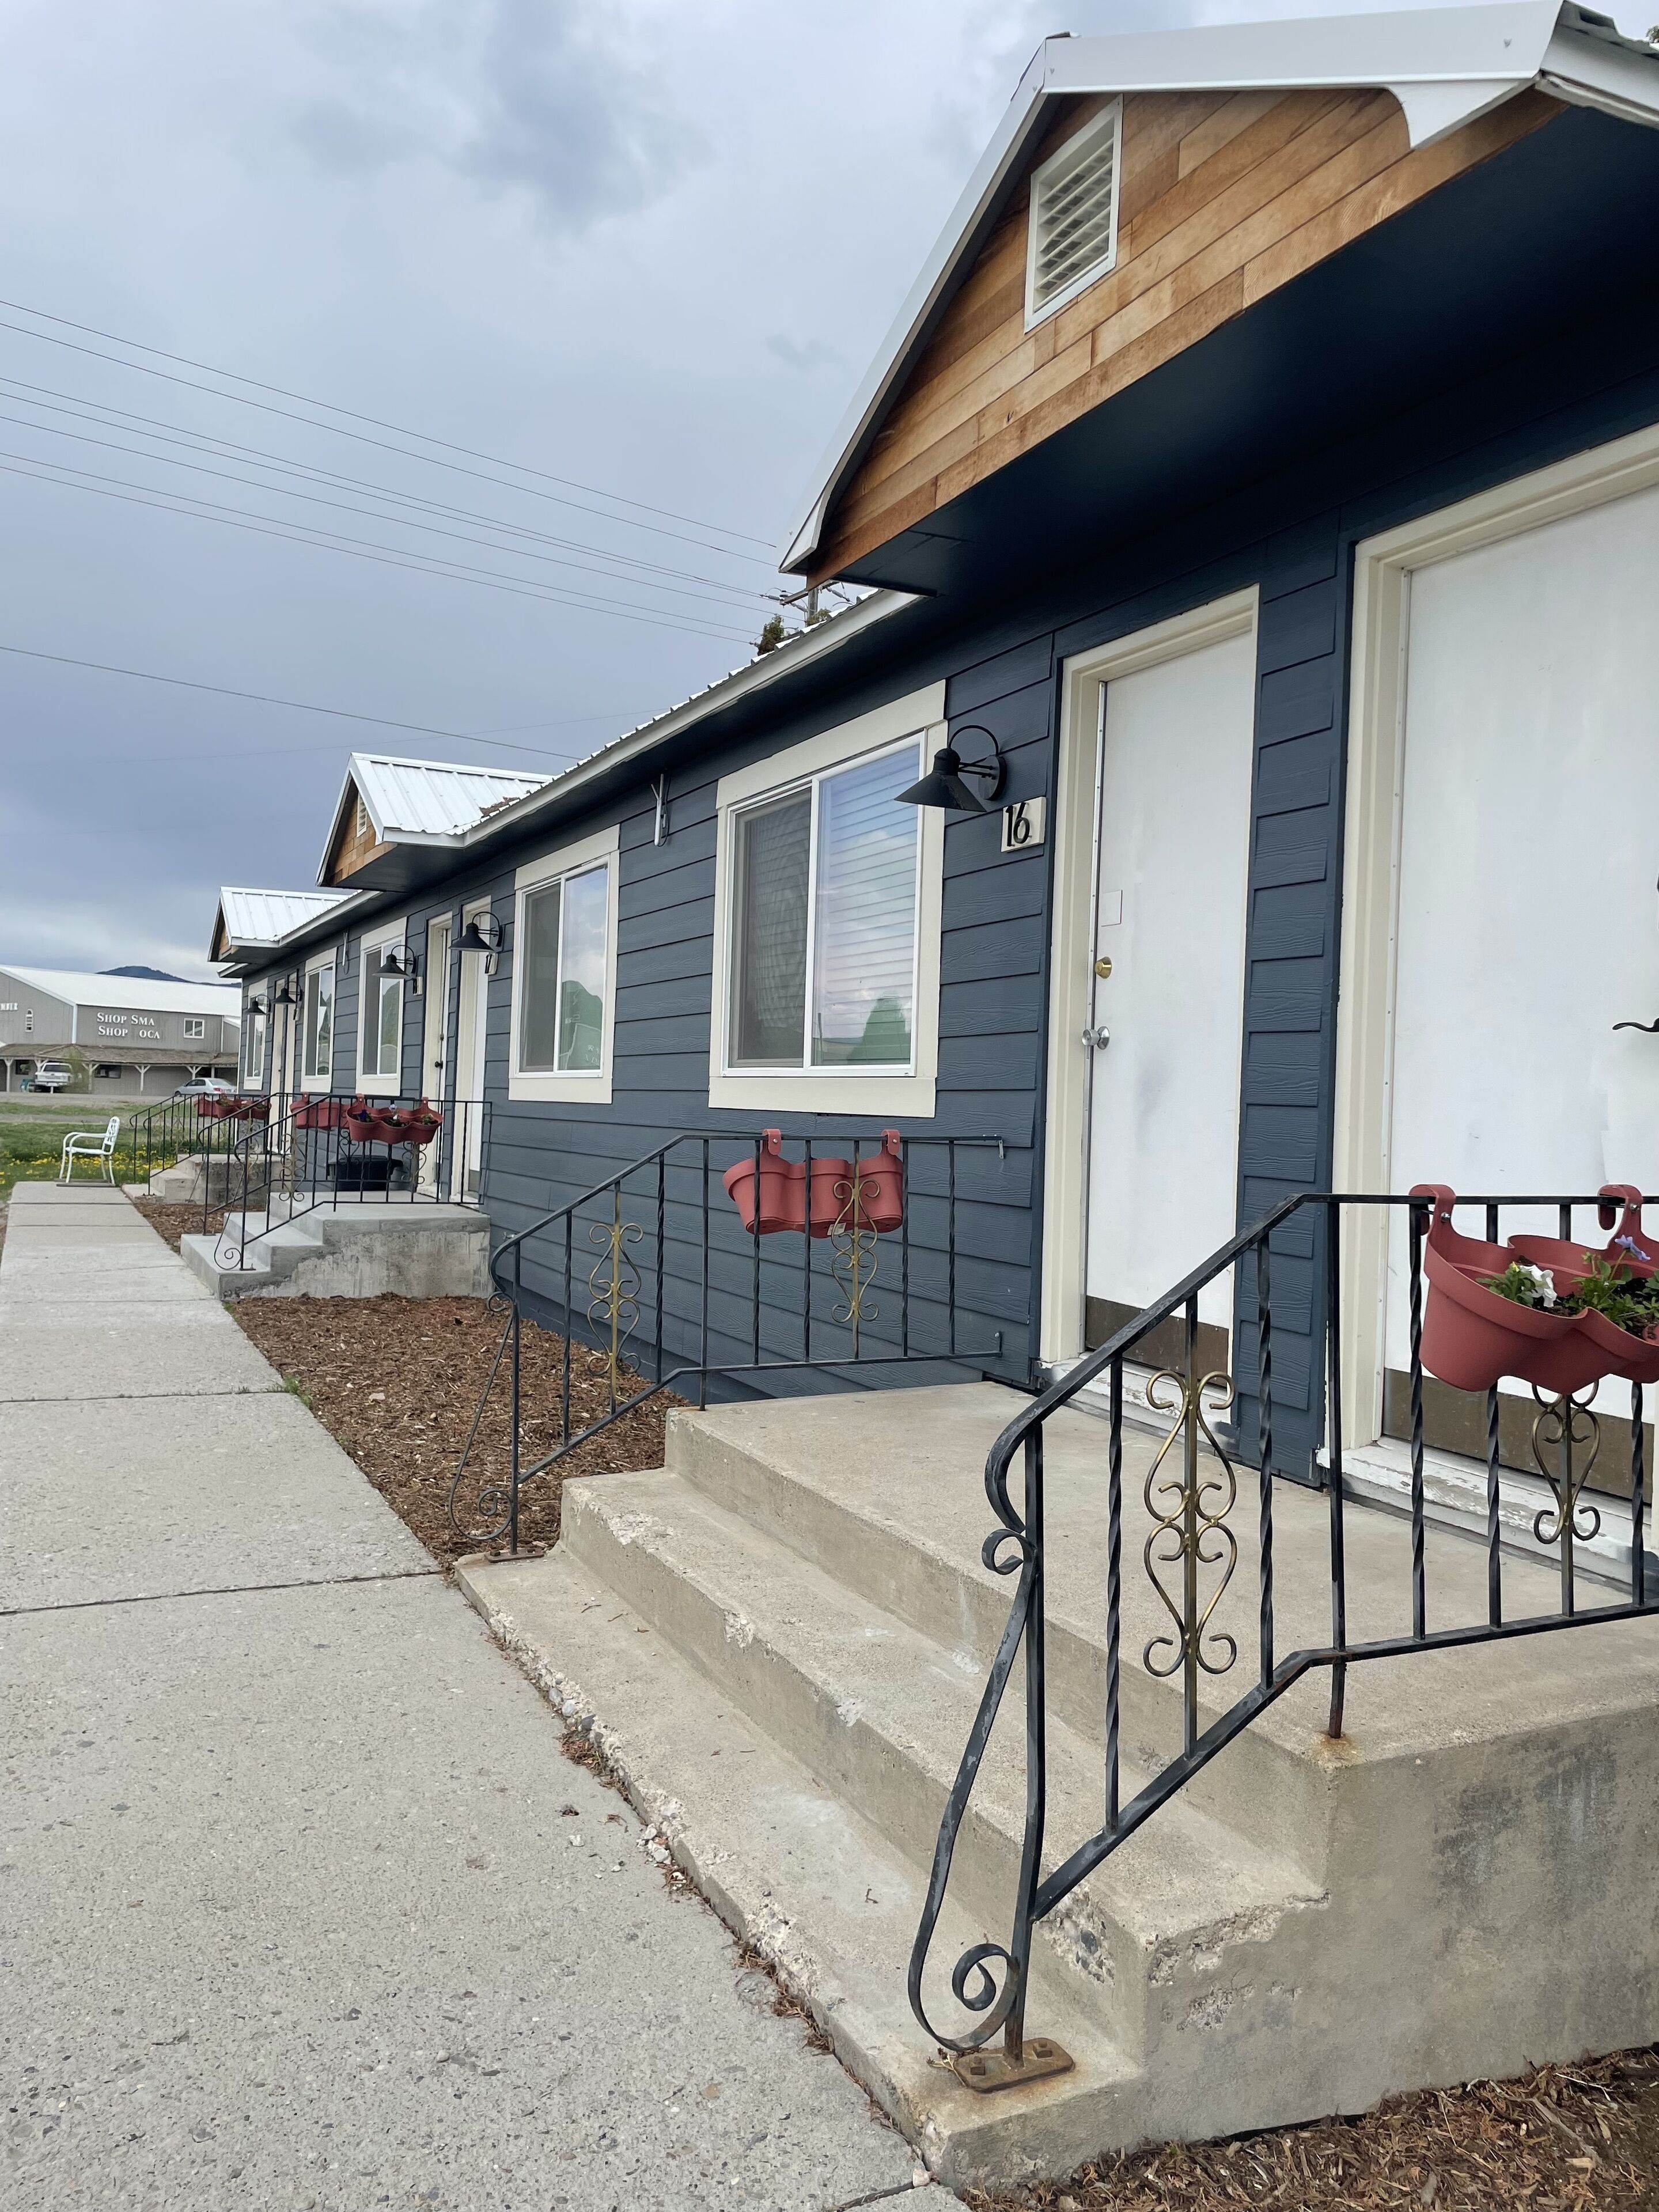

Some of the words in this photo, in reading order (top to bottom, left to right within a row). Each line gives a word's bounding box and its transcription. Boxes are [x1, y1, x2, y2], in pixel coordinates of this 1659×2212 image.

[1005, 802, 1030, 847] 16
[97, 1012, 127, 1024] SHOP
[131, 1014, 154, 1025] SMA
[98, 1025, 128, 1037] SHOP
[139, 1029, 160, 1039] OCA
